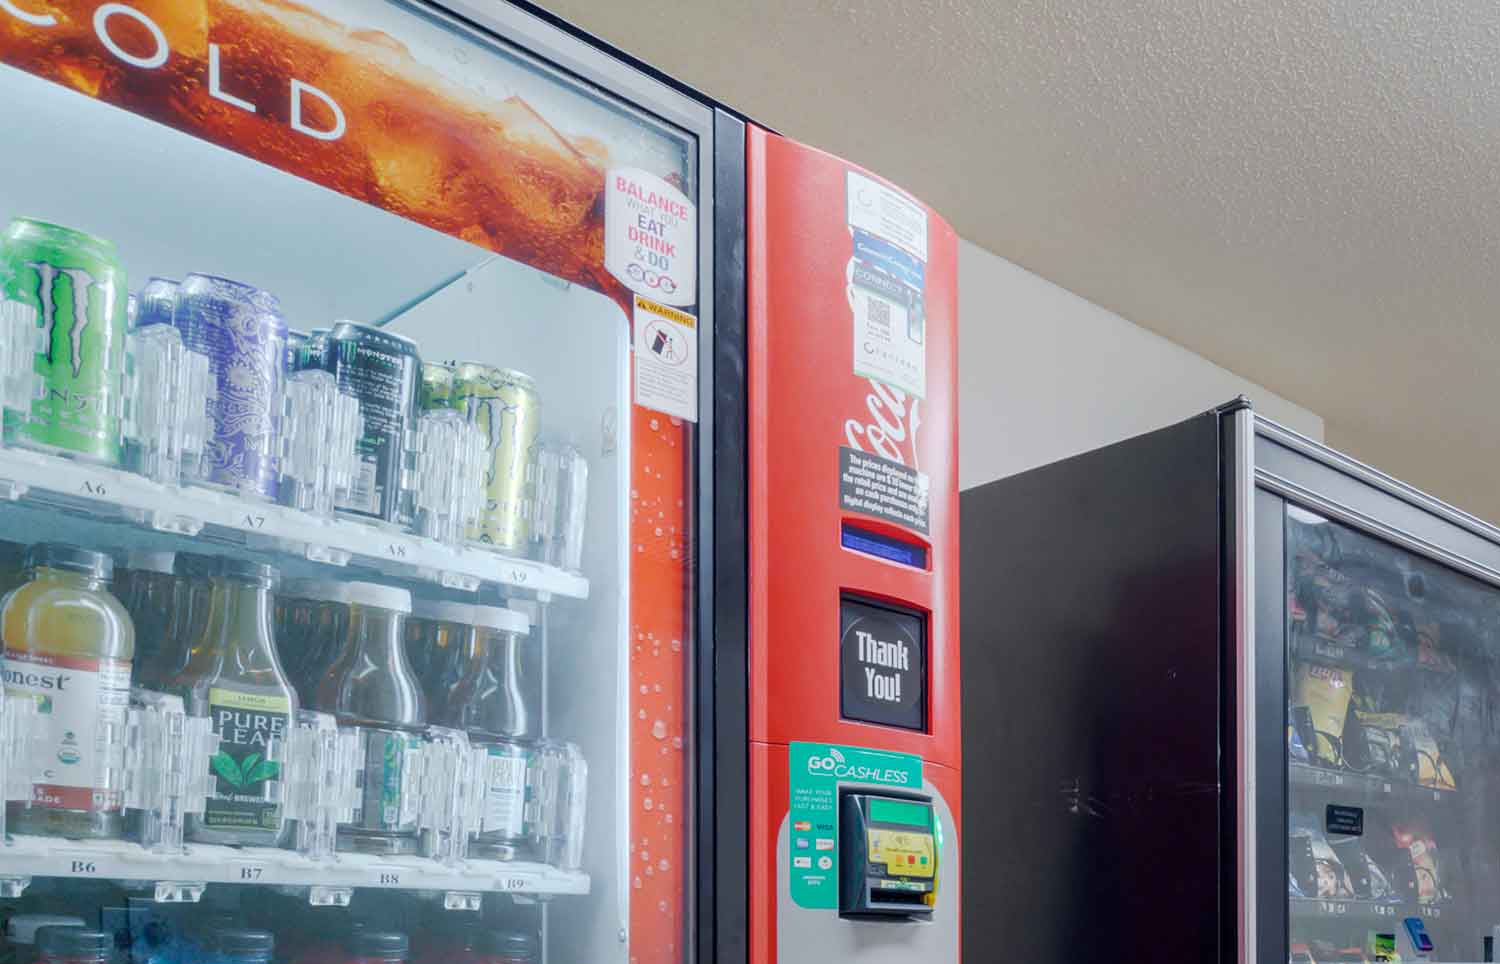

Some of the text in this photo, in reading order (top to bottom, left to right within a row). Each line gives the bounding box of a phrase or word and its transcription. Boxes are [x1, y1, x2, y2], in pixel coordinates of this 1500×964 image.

[616, 176, 688, 221] BALANCE
[638, 213, 666, 237] EAT
[628, 224, 676, 258] DRINK
[648, 251, 670, 271] DO
[80, 480, 107, 496] A6
[243, 514, 265, 530] A7
[384, 543, 406, 558] A8
[855, 630, 909, 671] Thank
[864, 667, 901, 702] You!
[219, 710, 284, 731] PURE
[807, 755, 908, 784] GO CASHLESS
[71, 859, 96, 874] B6
[241, 867, 263, 880] B7
[380, 874, 400, 885] B8
[507, 879, 525, 890] B9
